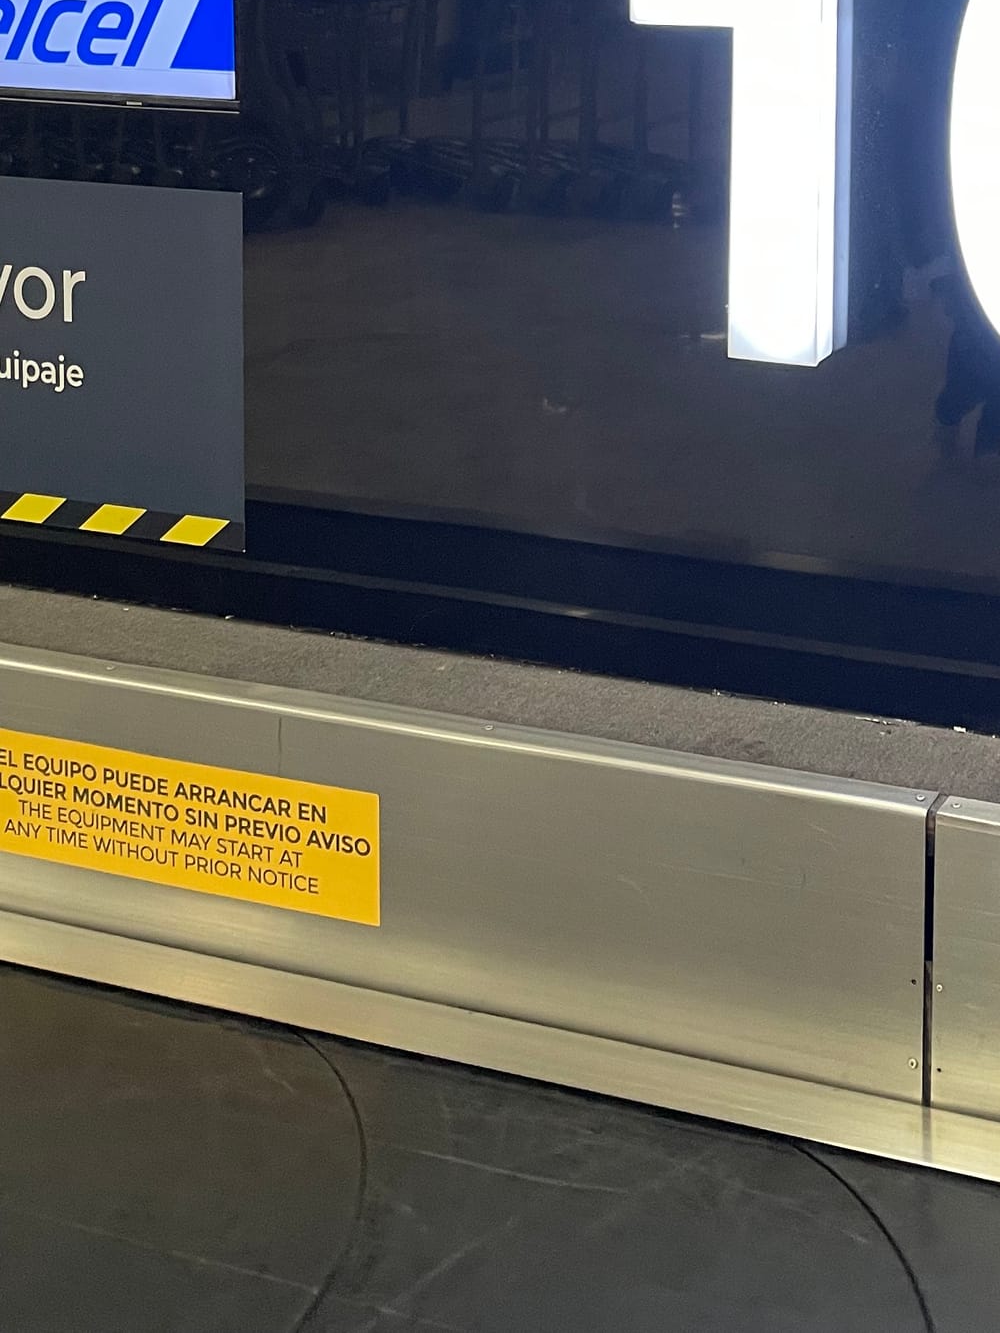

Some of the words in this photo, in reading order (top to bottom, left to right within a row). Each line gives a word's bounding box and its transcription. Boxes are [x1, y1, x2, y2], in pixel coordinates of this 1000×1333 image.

[0, 772, 67, 801] LQUIER
[73, 786, 179, 822] MOMENTO
[185, 808, 218, 830] SIN
[225, 814, 301, 845] PREVIO
[307, 829, 371, 857] AVISO
[23, 753, 97, 781] EQUIPO
[103, 767, 169, 796] PUEDE
[174, 782, 291, 817] ARRANCAR
[298, 802, 327, 824] EN
[4, 819, 41, 840] ANY
[46, 825, 88, 849] TIME
[94, 836, 179, 867] WITHOUT
[185, 854, 242, 880] PRIOR
[248, 866, 319, 895] NOTICE
[18, 799, 52, 820] THE
[58, 808, 165, 841] EQUIPMENT
[171, 828, 211, 850] MAY
[216, 837, 272, 863] START
[279, 850, 303, 868] AT
